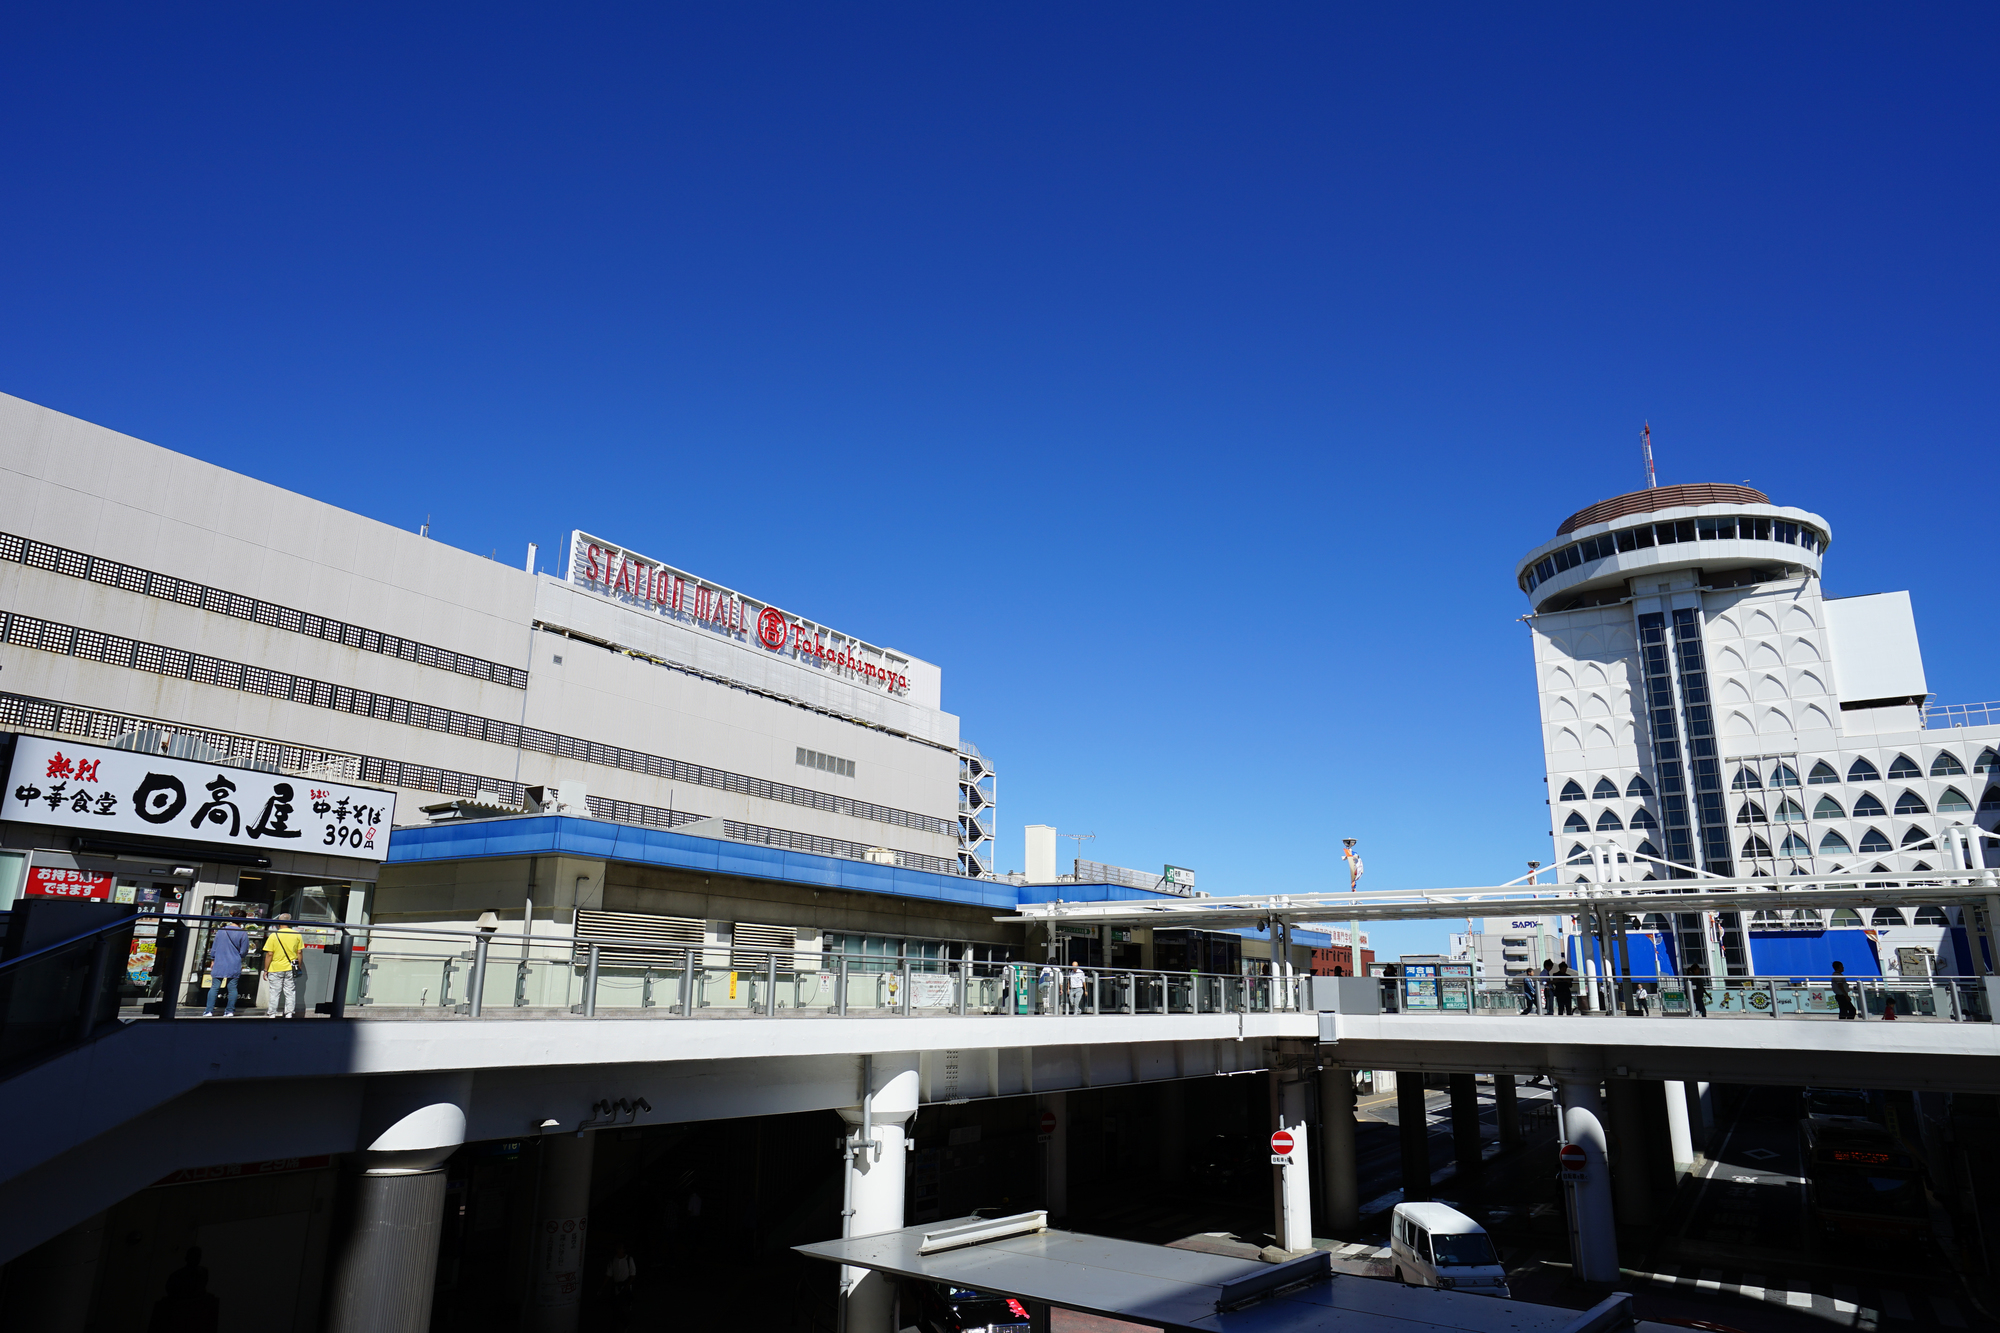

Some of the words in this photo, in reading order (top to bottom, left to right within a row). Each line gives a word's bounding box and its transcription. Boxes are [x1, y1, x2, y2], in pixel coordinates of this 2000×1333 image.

[586, 543, 685, 612] STATION
[694, 585, 747, 634] MALL
[790, 623, 907, 691] Takashimaya
[45, 751, 102, 784] 熱烈
[14, 781, 118, 817] 中華食堂
[312, 796, 386, 826] 中華そば
[42, 884, 96, 896] できます
[1511, 921, 1539, 929] SAPIX
